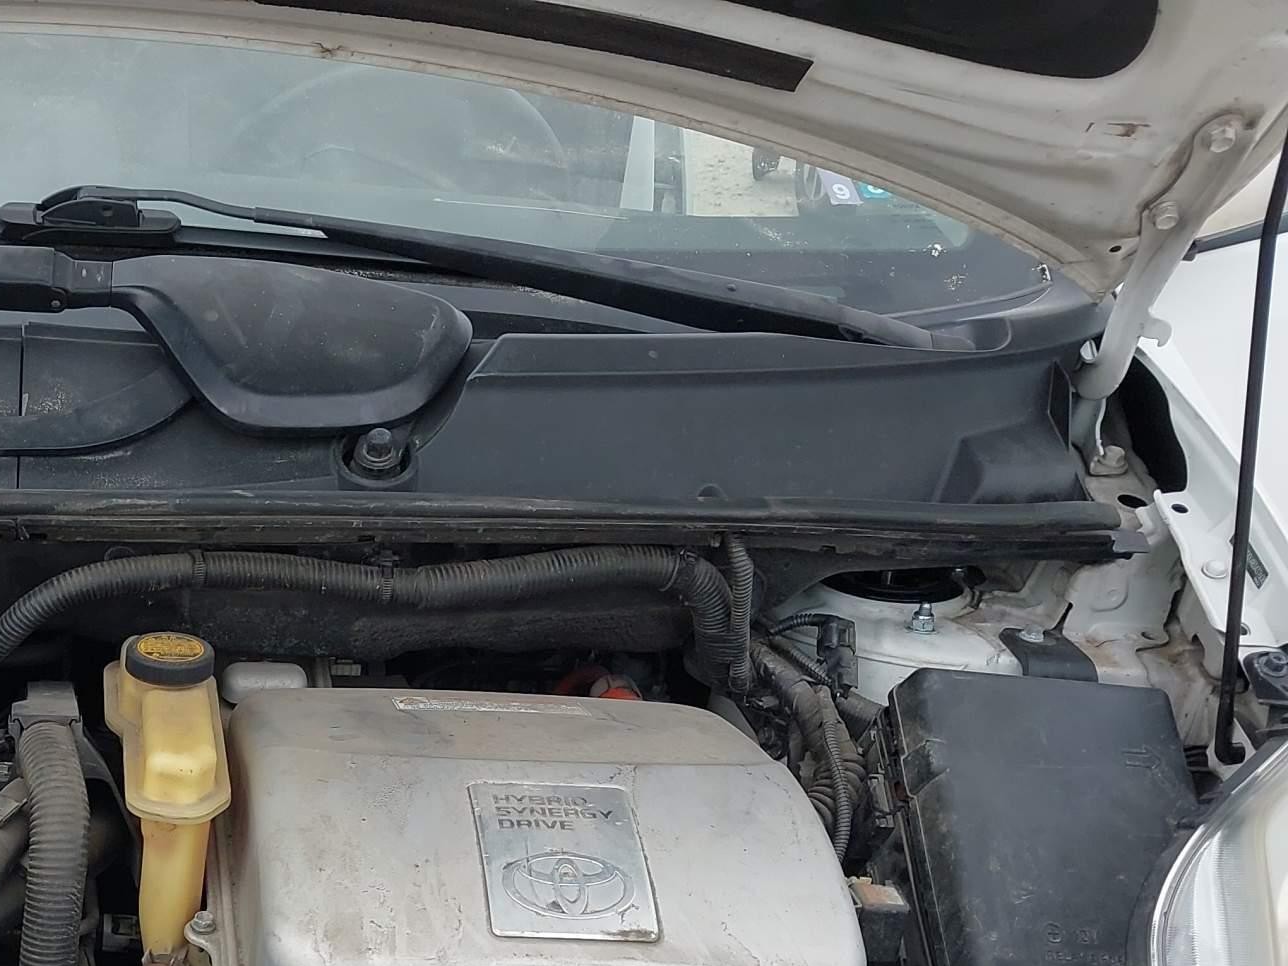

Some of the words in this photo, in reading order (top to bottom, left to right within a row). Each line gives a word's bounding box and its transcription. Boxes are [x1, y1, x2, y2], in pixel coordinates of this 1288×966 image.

[492, 793, 589, 807] HYBRID
[494, 806, 613, 820] SYNERGY
[497, 819, 576, 831] DRIVE
